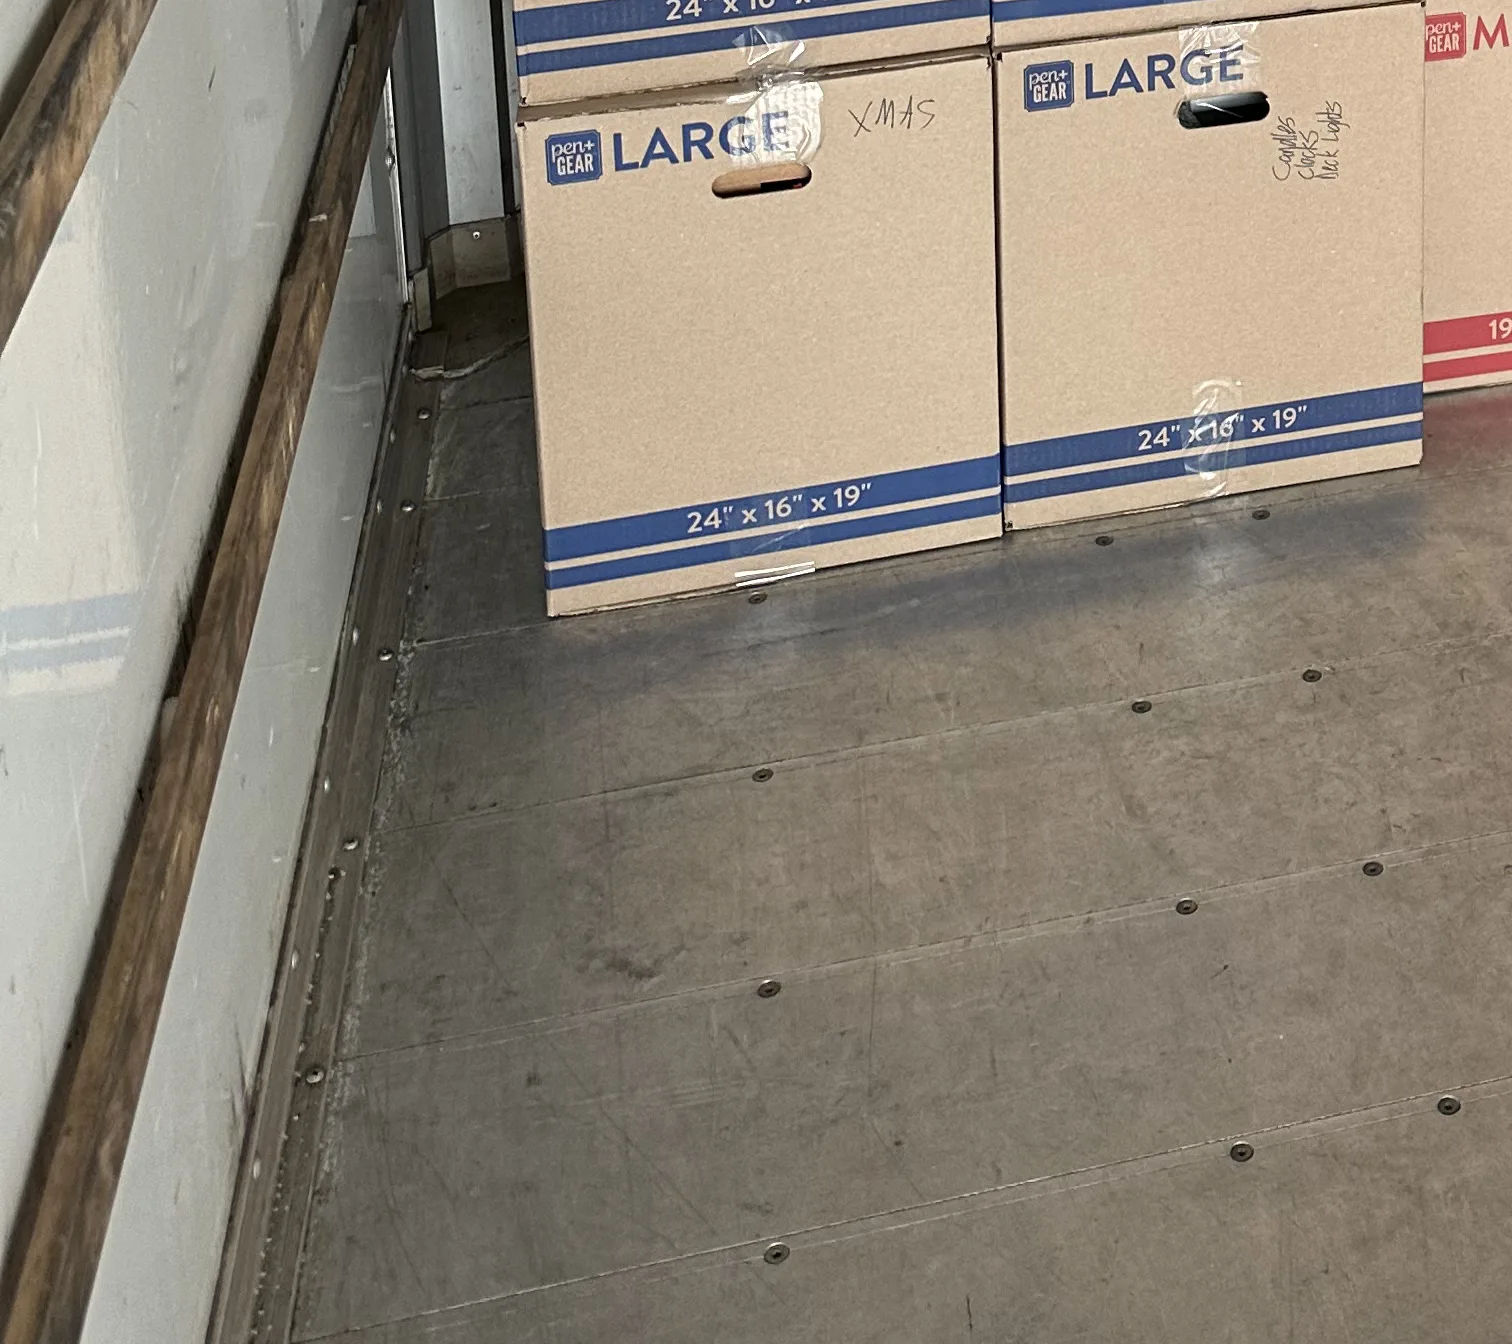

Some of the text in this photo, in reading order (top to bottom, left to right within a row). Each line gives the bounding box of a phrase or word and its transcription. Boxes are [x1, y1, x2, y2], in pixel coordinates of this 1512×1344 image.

[1428, 34, 1460, 54] GEAR
[1033, 81, 1067, 103] GEAR
[1085, 44, 1244, 100] LARGE
[848, 94, 935, 138] XMAS
[613, 111, 789, 172] LARGE
[557, 153, 594, 176] GEAR
[1137, 424, 1181, 450] 24"
[1188, 427, 1202, 443] x
[1251, 417, 1266, 433] x
[1272, 405, 1307, 429] 19"
[687, 482, 872, 533] 24" x 16" x 19"
